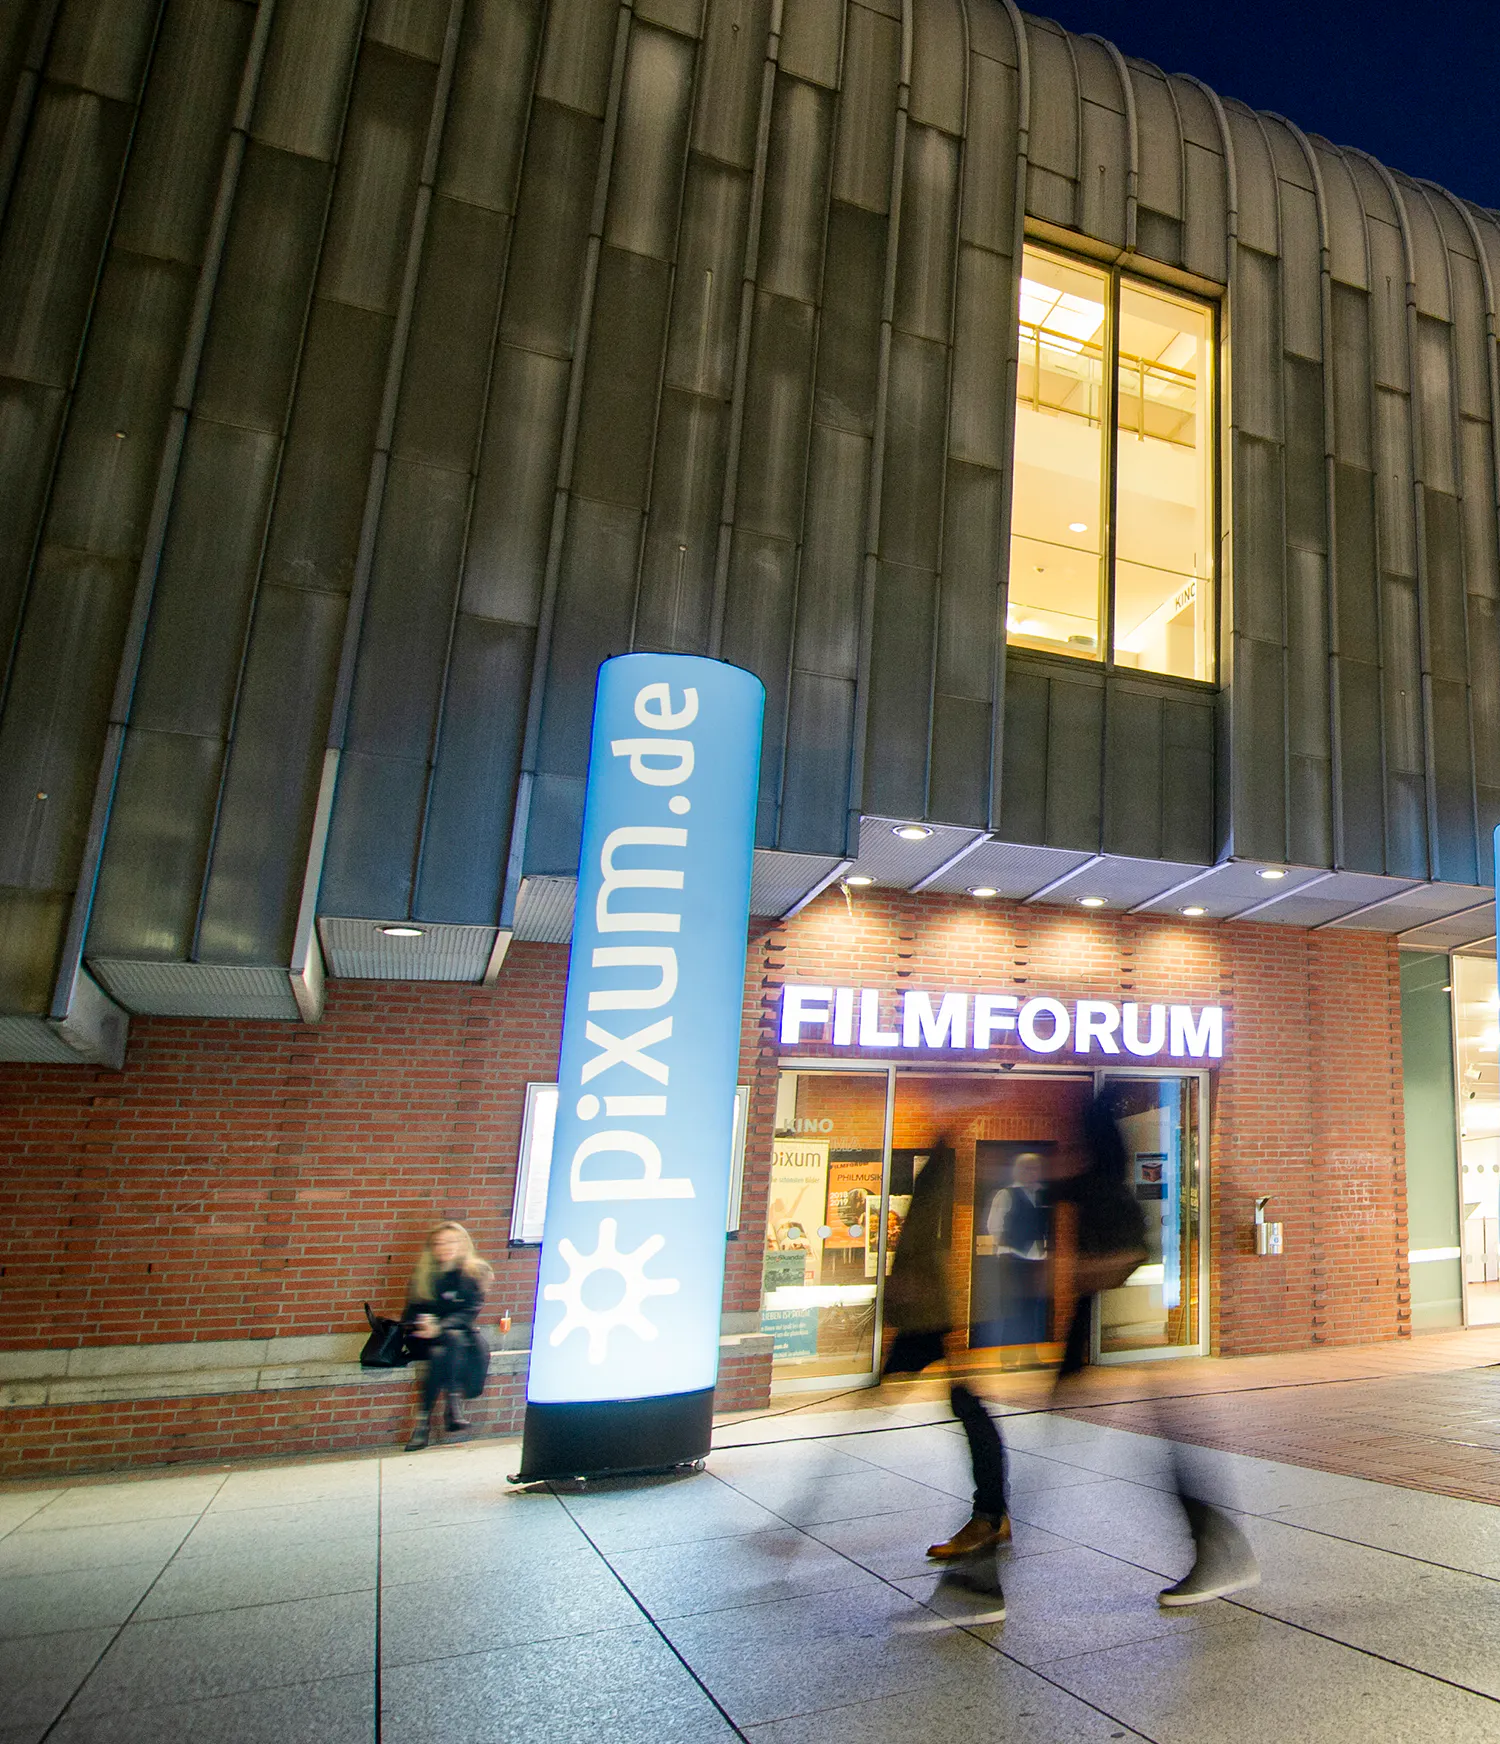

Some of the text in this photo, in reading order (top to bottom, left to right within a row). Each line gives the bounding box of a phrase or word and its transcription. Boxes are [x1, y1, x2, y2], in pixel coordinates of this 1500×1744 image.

[570, 682, 700, 1202] pixum.de
[779, 984, 1224, 1058] FILMFORUM
[783, 1118, 834, 1133] KINO
